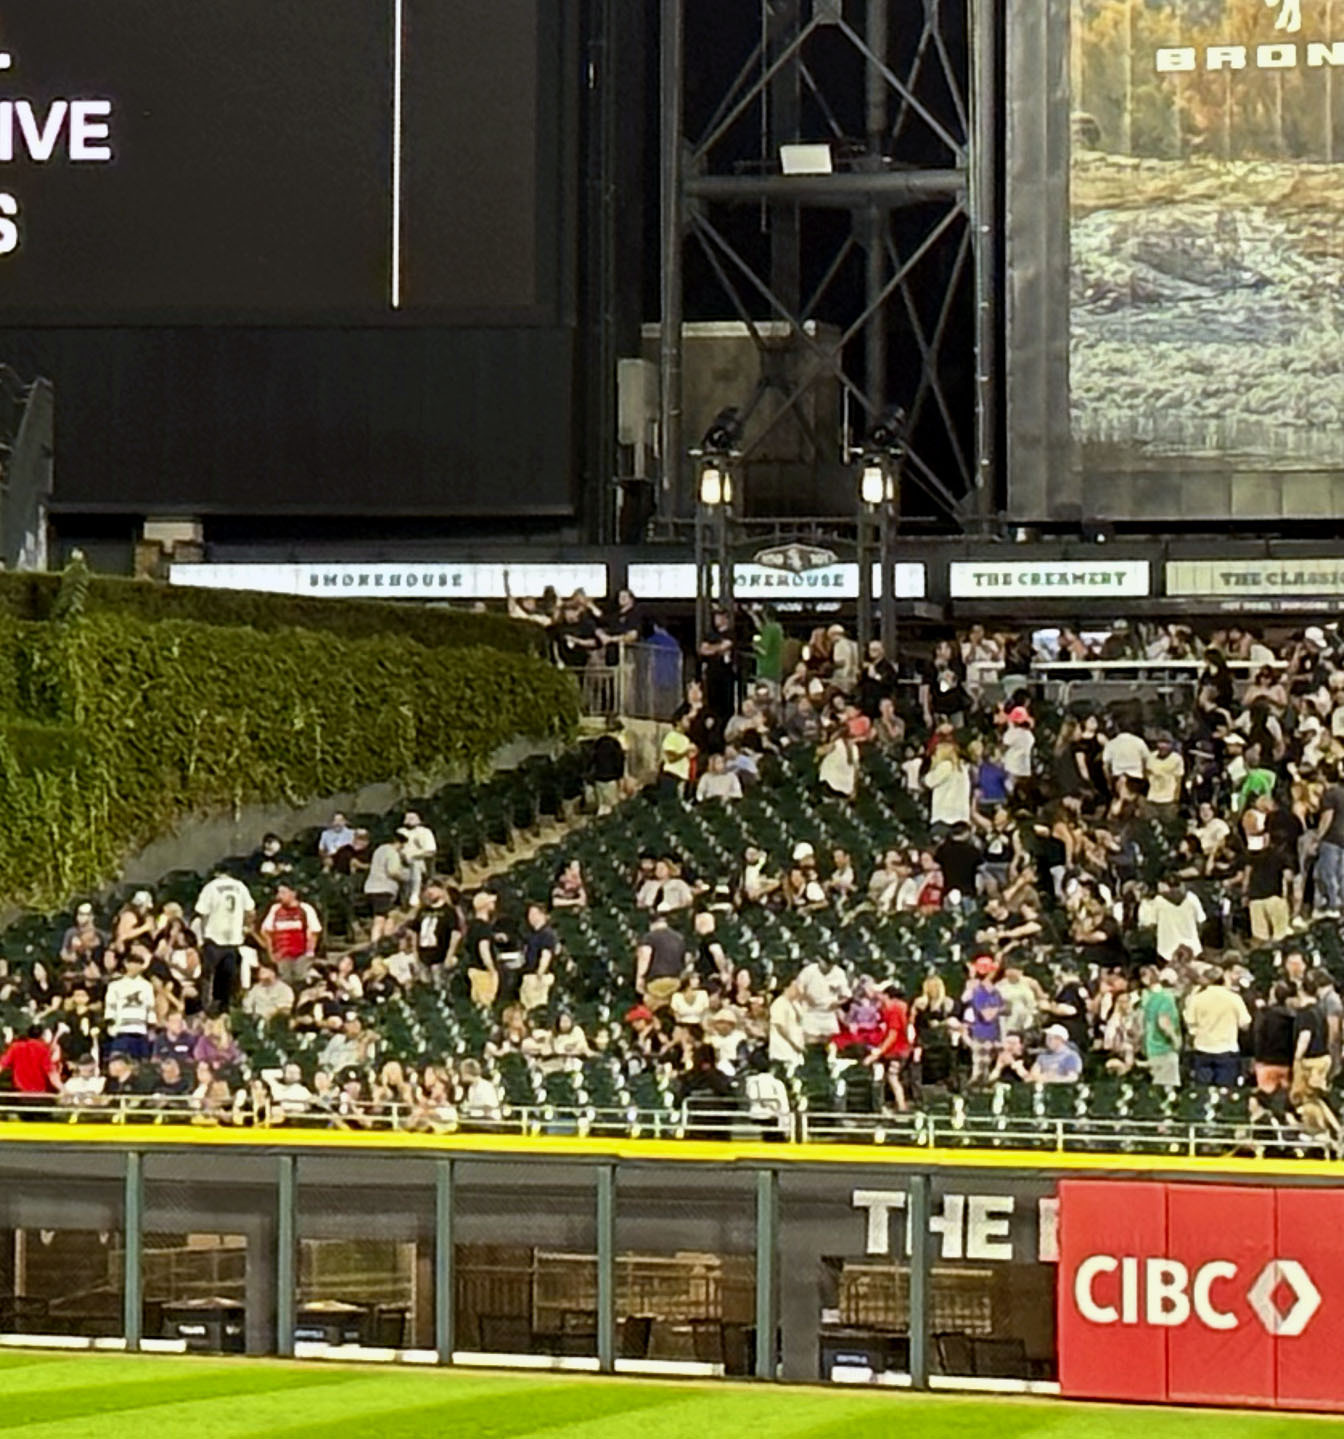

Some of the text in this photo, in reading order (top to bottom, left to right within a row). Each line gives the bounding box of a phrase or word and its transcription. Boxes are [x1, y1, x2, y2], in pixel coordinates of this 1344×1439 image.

[972, 572, 1013, 587] THE
[1220, 572, 1262, 586] THE
[853, 1189, 1014, 1260] THE
[1074, 1254, 1240, 1330] CIBC
